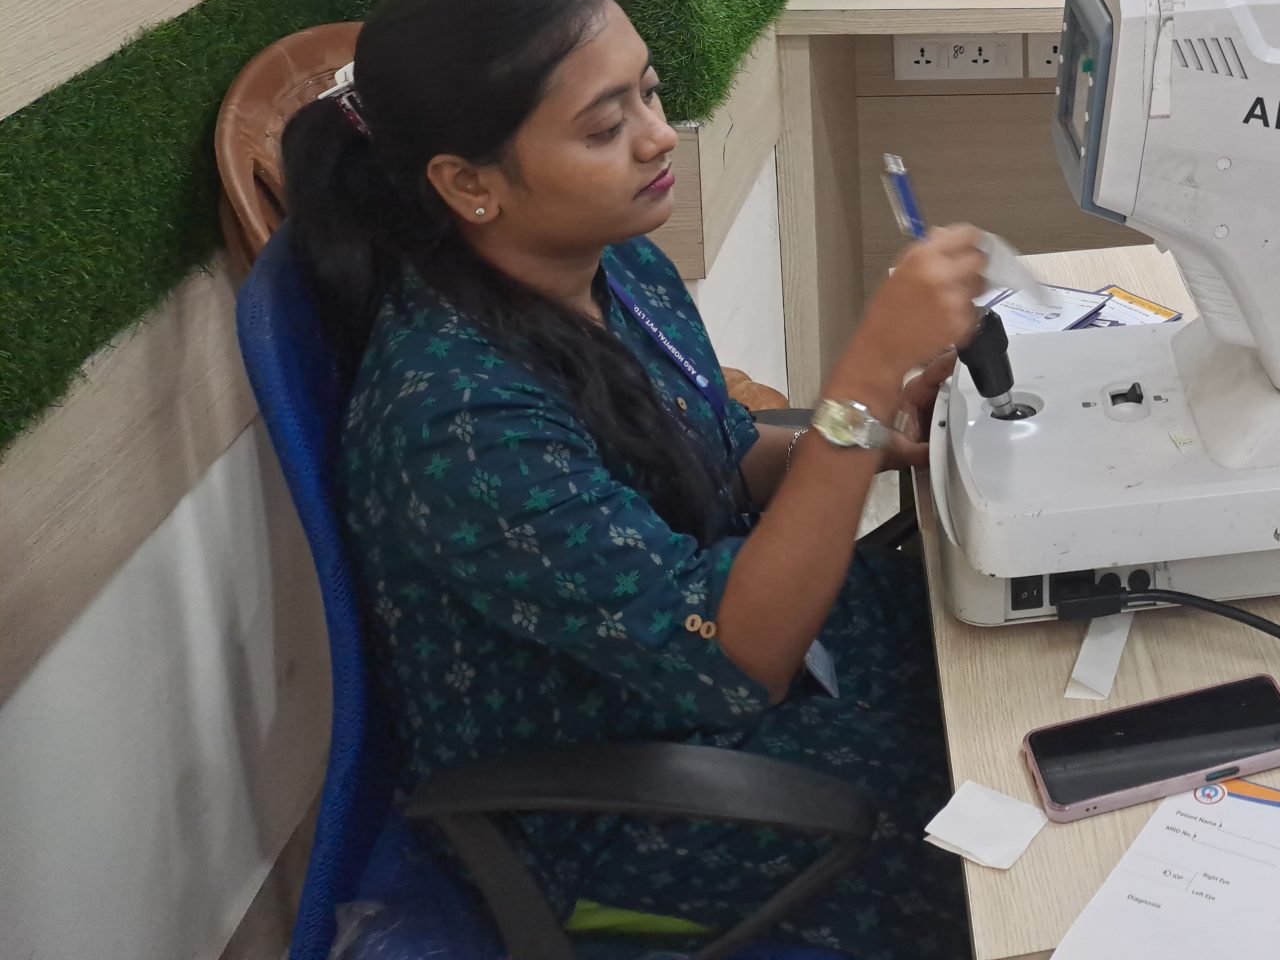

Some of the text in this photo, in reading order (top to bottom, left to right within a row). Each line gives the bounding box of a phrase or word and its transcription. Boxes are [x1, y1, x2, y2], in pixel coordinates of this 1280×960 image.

[658, 331, 684, 362] HOSPITAL
[683, 361, 697, 375] ASG
[1199, 817, 1217, 827] Name
[1127, 893, 1162, 910] Diagnosis
